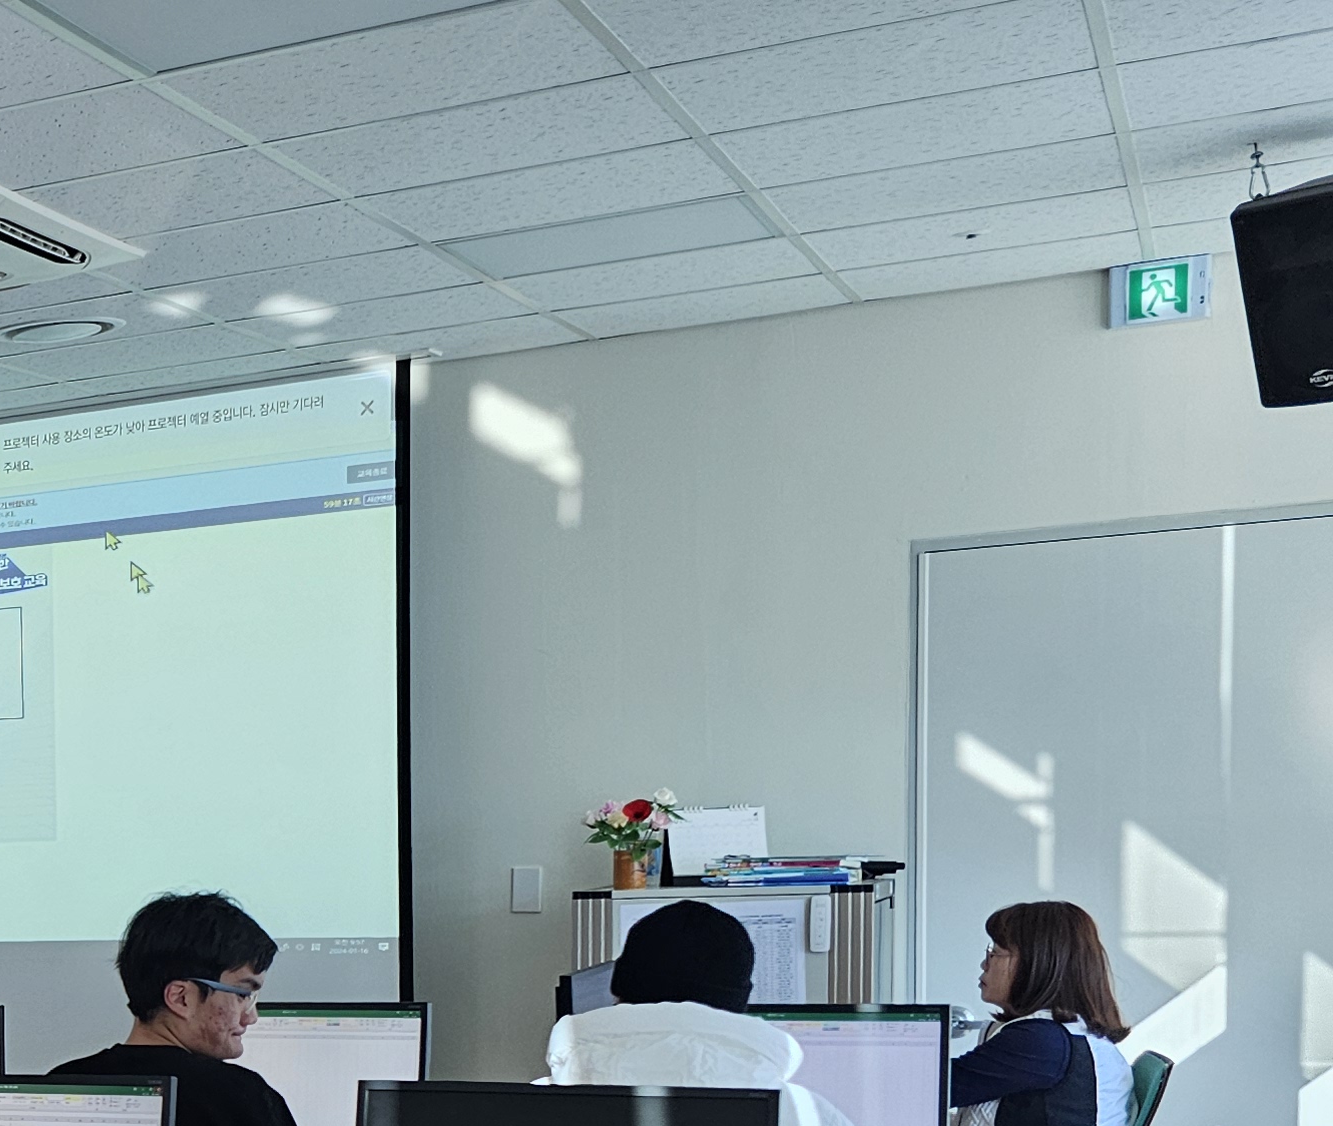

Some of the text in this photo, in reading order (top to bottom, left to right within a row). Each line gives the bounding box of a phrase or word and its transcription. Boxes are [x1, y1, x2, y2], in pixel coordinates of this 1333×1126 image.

[3, 394, 325, 451] 프로젝터 사용 장소의 온도가 낮아 프로젝터 예열 중입니다. 잠시만 기다려
[3, 459, 33, 474] 주세요.
[23, 573, 47, 588] 교육
